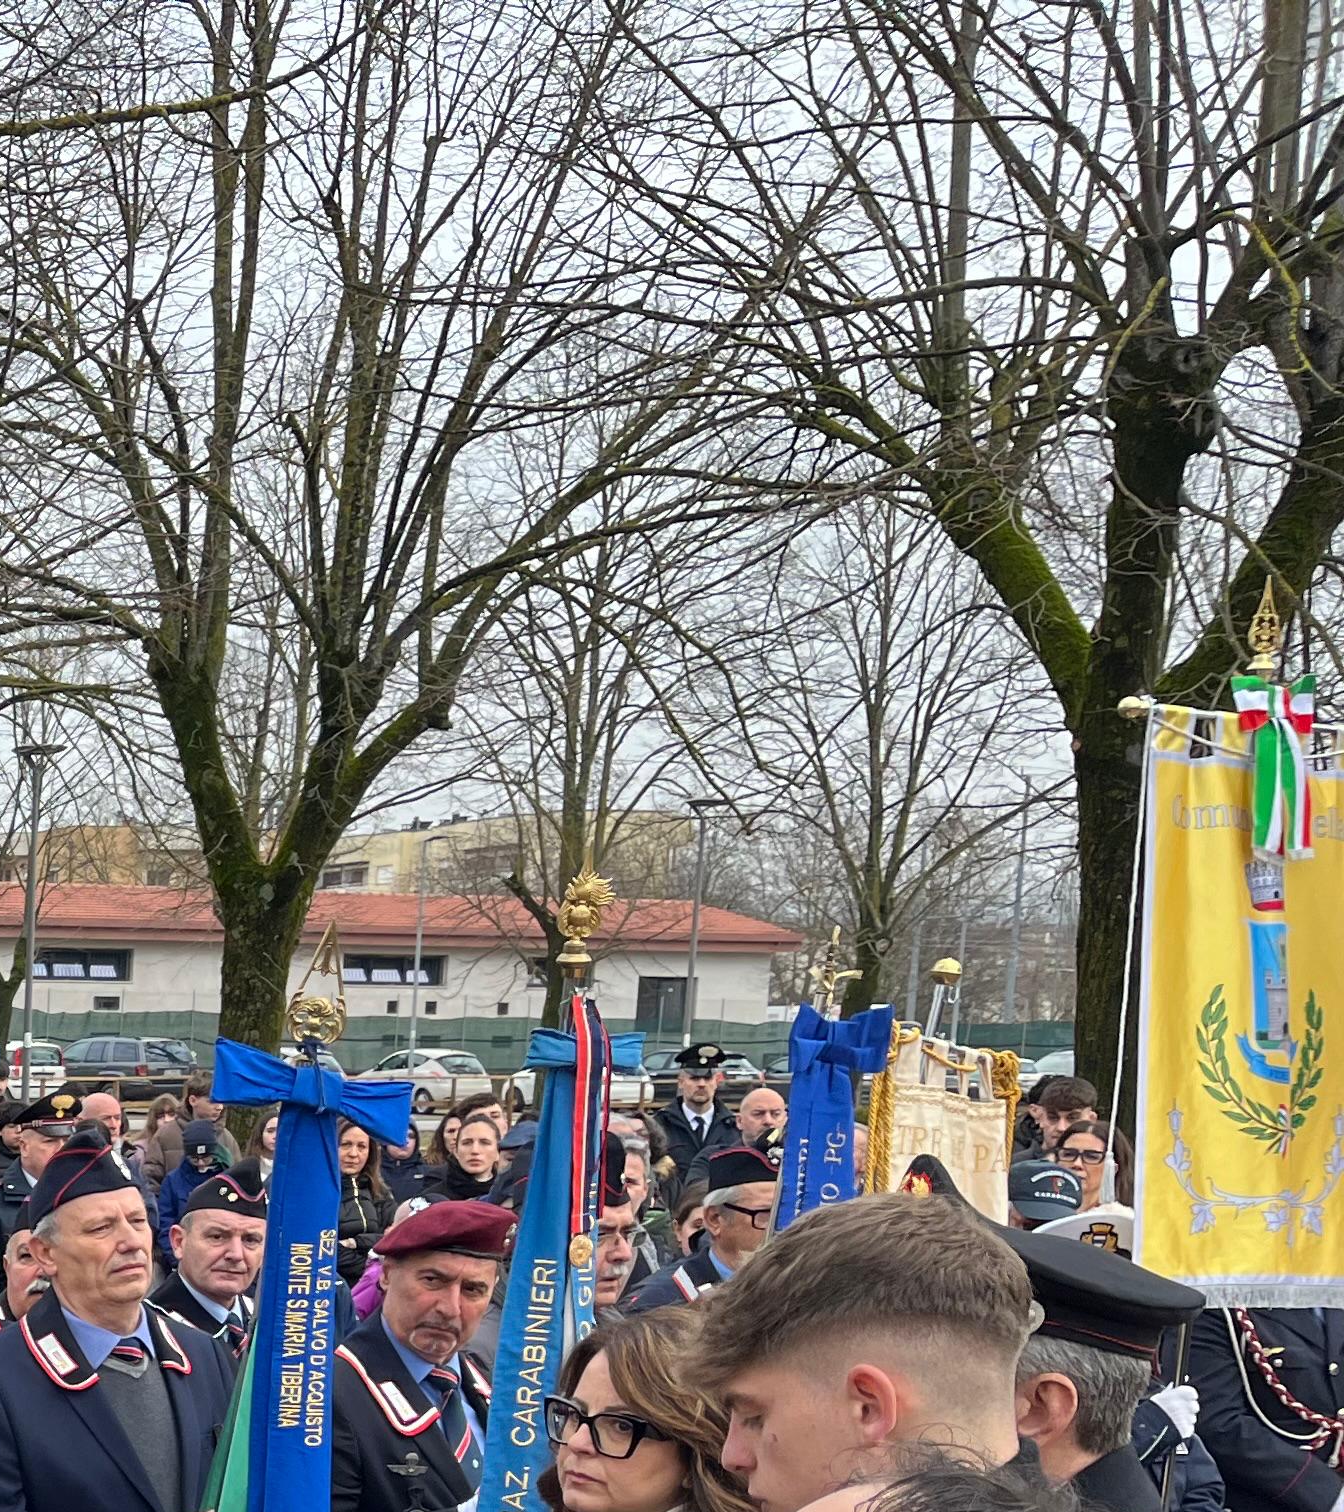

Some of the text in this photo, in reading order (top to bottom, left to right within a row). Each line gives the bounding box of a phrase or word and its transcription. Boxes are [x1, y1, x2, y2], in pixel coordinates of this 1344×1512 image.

[288, 1242, 314, 1295] MONTE
[310, 1298, 330, 1350] SALVO
[511, 1258, 557, 1447] CARABINIERI
[278, 1362, 304, 1428] TIBERINA
[303, 1354, 327, 1447] D'ACQUISTO
